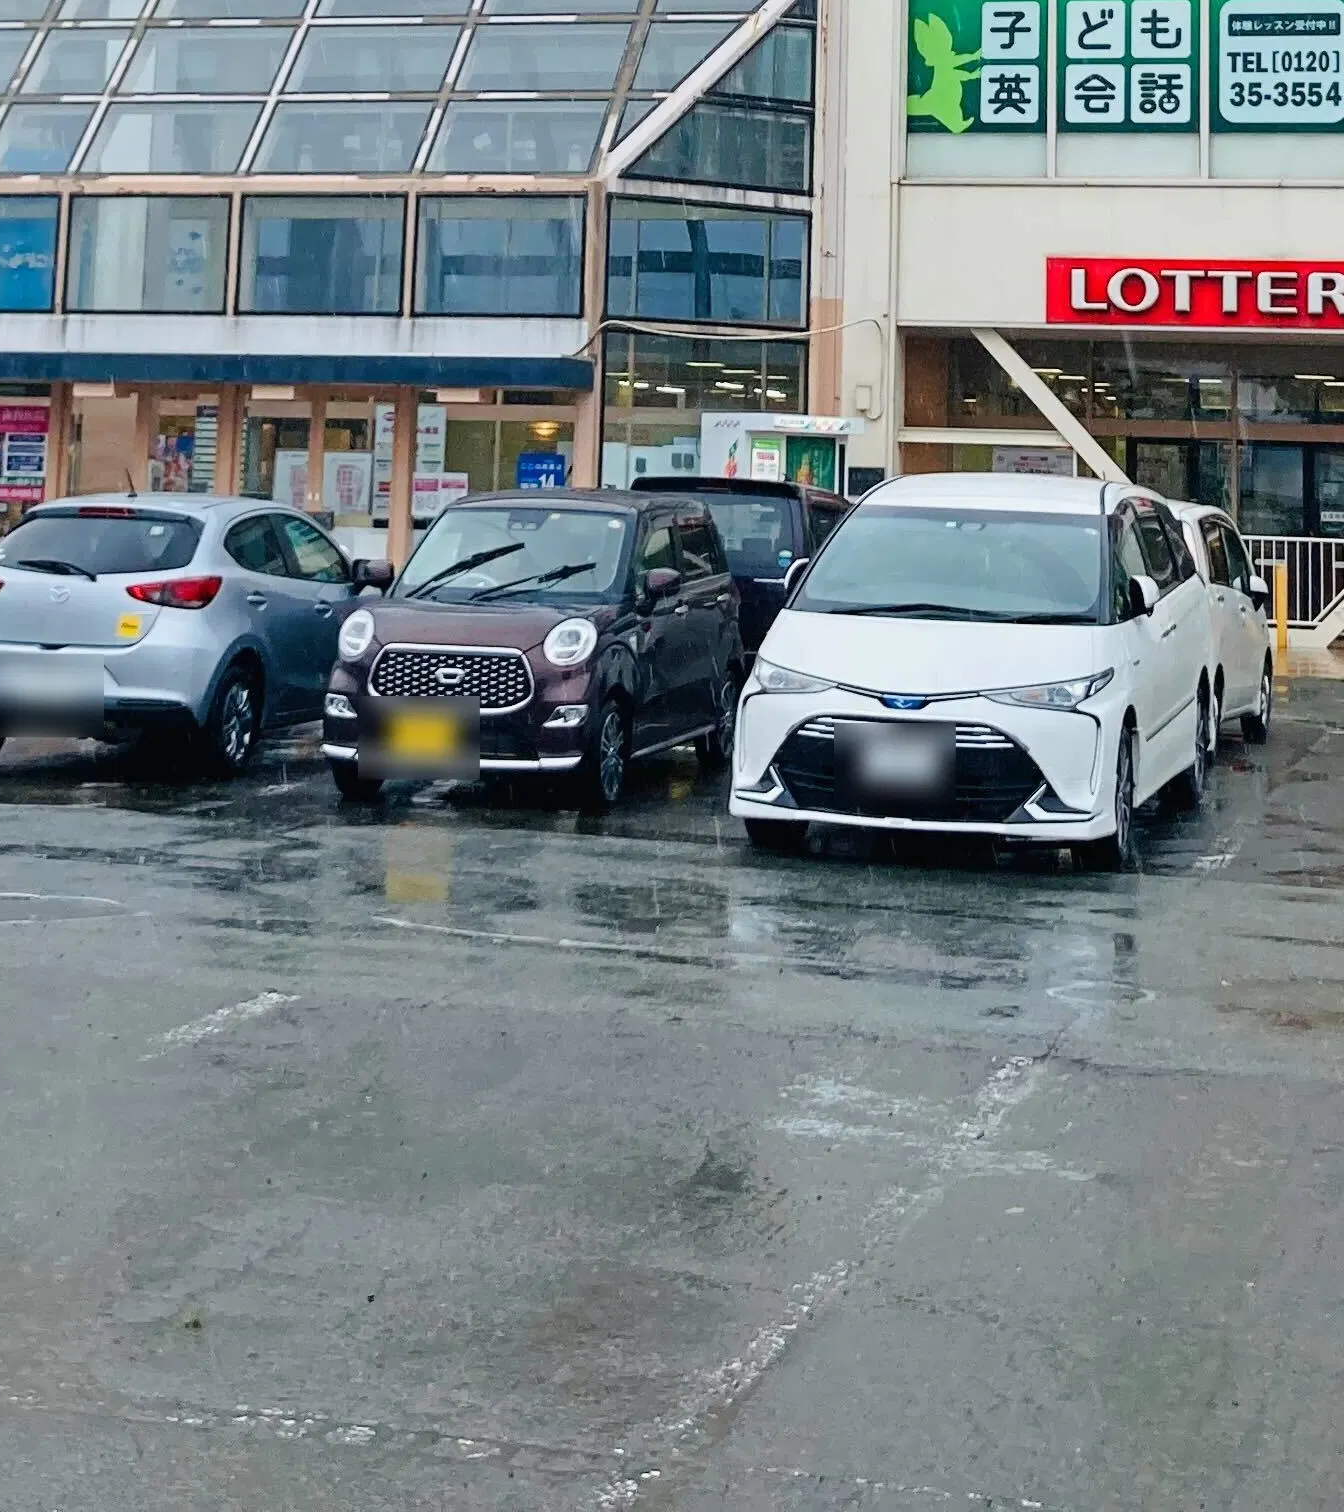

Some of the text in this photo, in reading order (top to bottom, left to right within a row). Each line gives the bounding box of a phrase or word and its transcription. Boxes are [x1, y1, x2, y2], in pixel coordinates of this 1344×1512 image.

[989, 8, 1182, 51] 子ども
[1226, 51, 1269, 73] TEL
[987, 72, 1184, 115] 英会話
[1229, 81, 1342, 107] 35-3554
